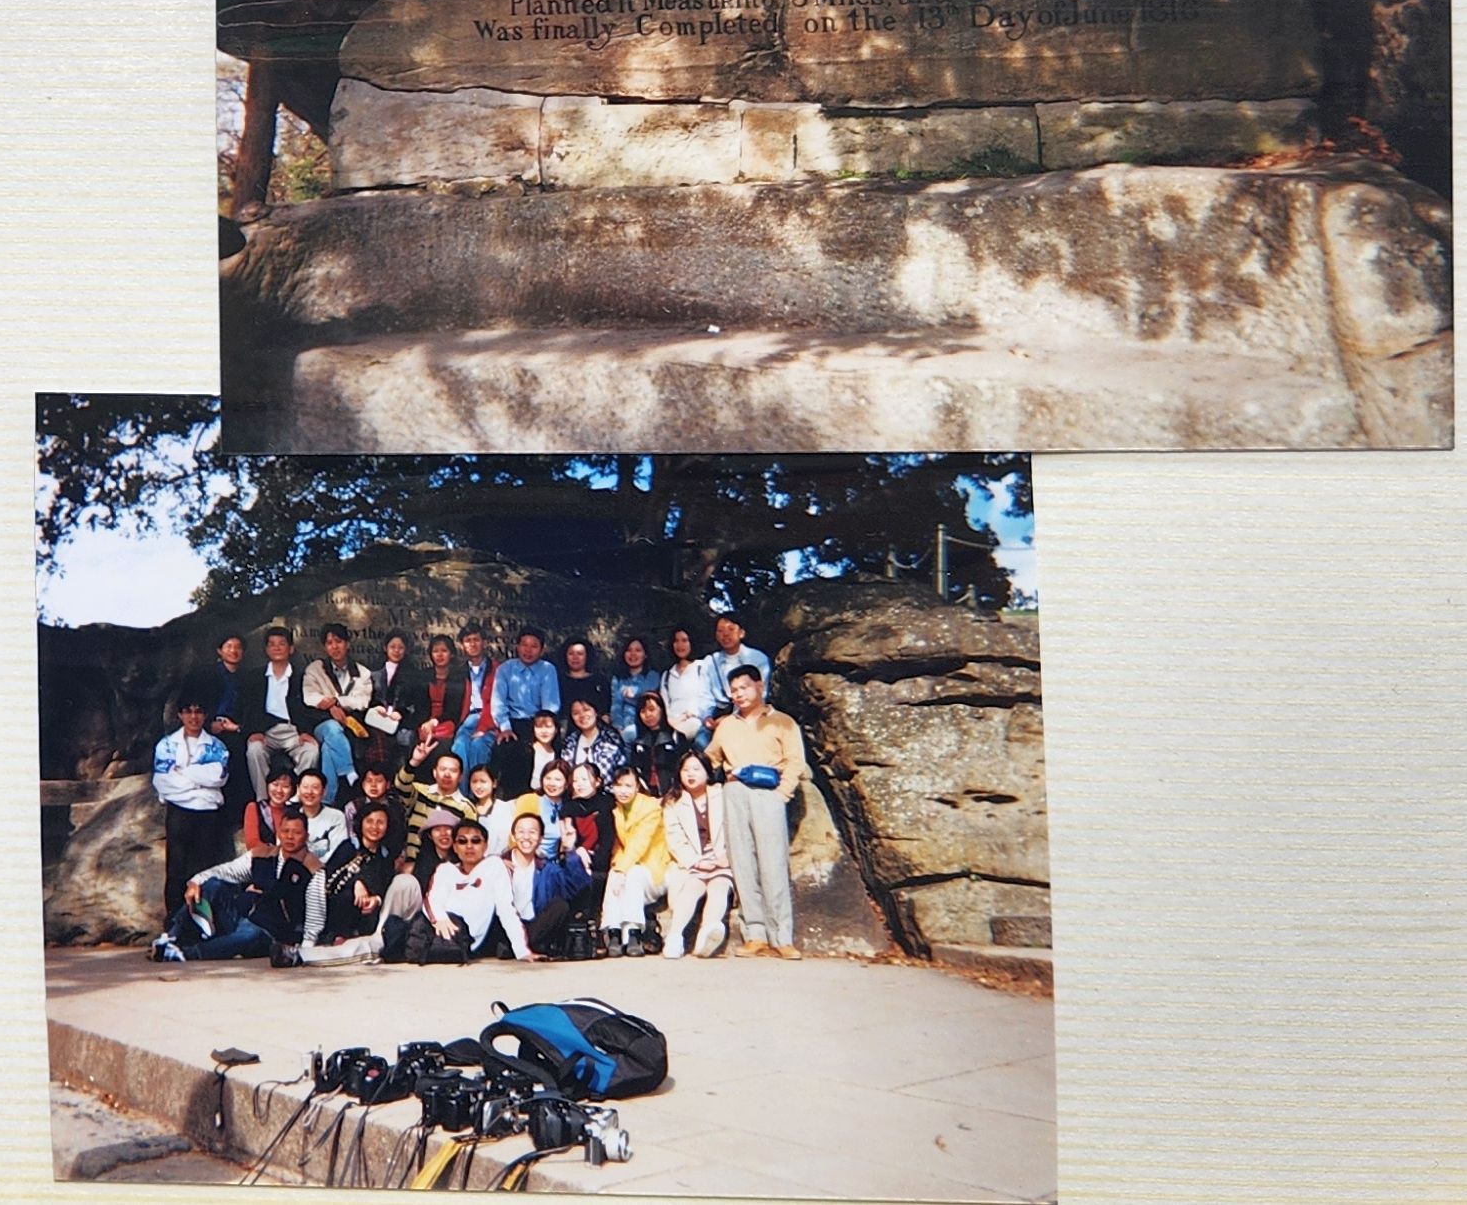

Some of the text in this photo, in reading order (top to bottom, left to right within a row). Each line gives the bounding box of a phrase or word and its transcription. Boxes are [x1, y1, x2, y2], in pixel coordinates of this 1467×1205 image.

[473, 19, 524, 42] Was
[533, 16, 614, 51] finally
[636, 14, 778, 44] Completed
[804, 15, 836, 34] on
[848, 8, 897, 33] the
[970, 4, 1032, 41] Day
